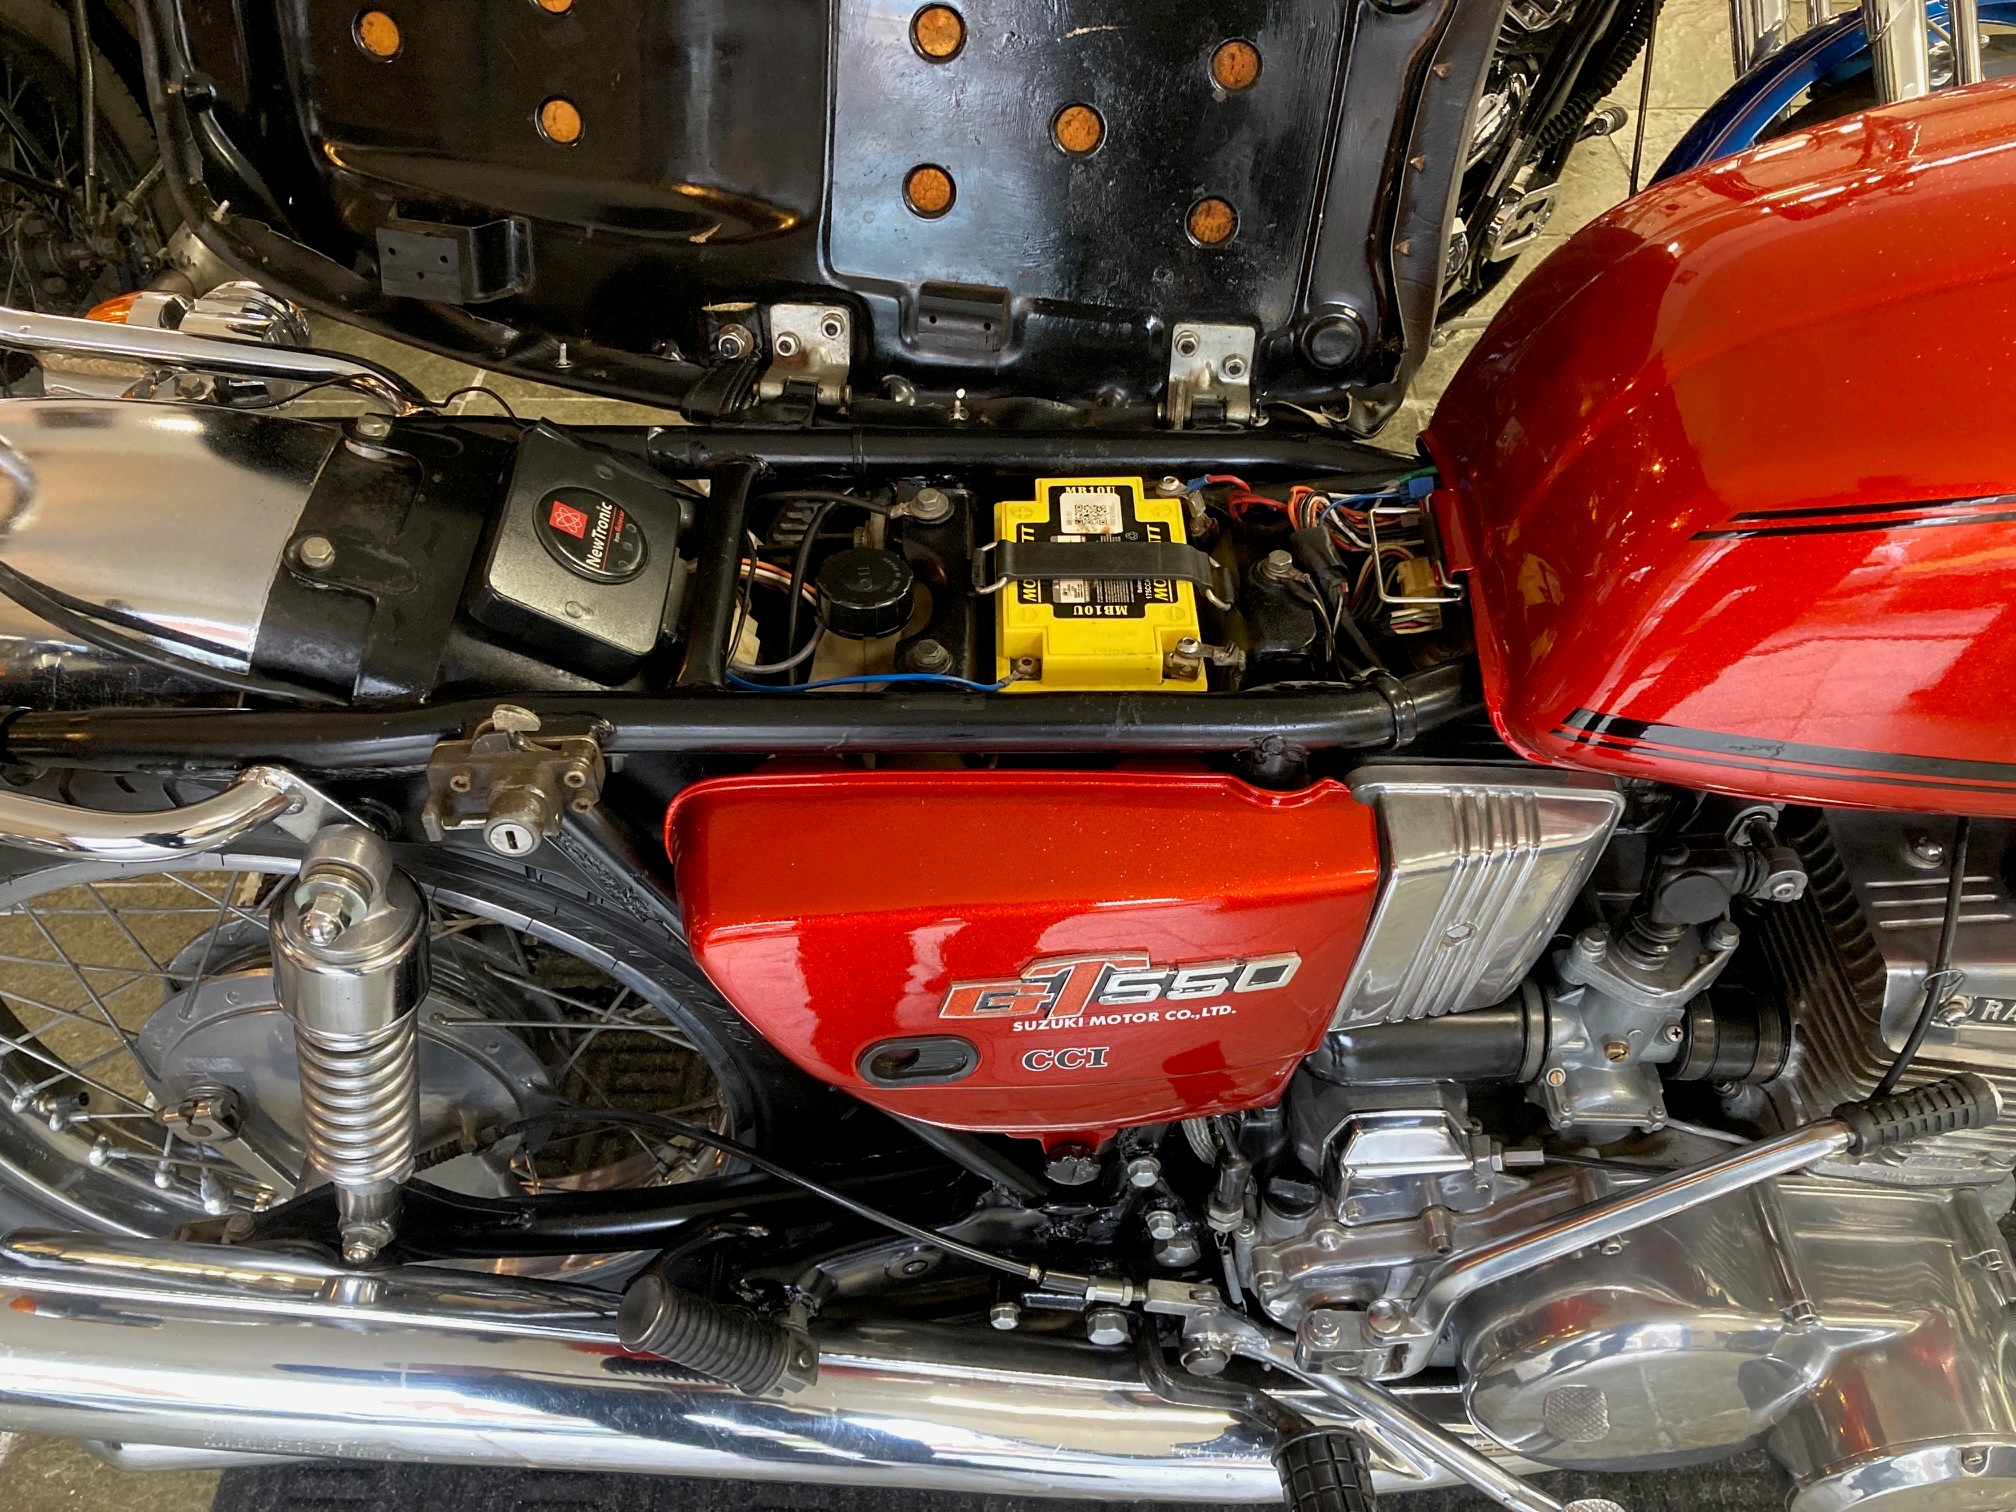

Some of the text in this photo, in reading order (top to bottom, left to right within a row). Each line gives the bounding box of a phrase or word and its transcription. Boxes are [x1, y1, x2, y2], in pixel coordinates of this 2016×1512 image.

[585, 501, 613, 568] NewTronic
[1073, 605, 1128, 616] MB10U
[1013, 1016, 1084, 1032] SUZUKI
[1089, 1008, 1160, 1026] MOTOR
[1021, 1046, 1110, 1072] CCI
